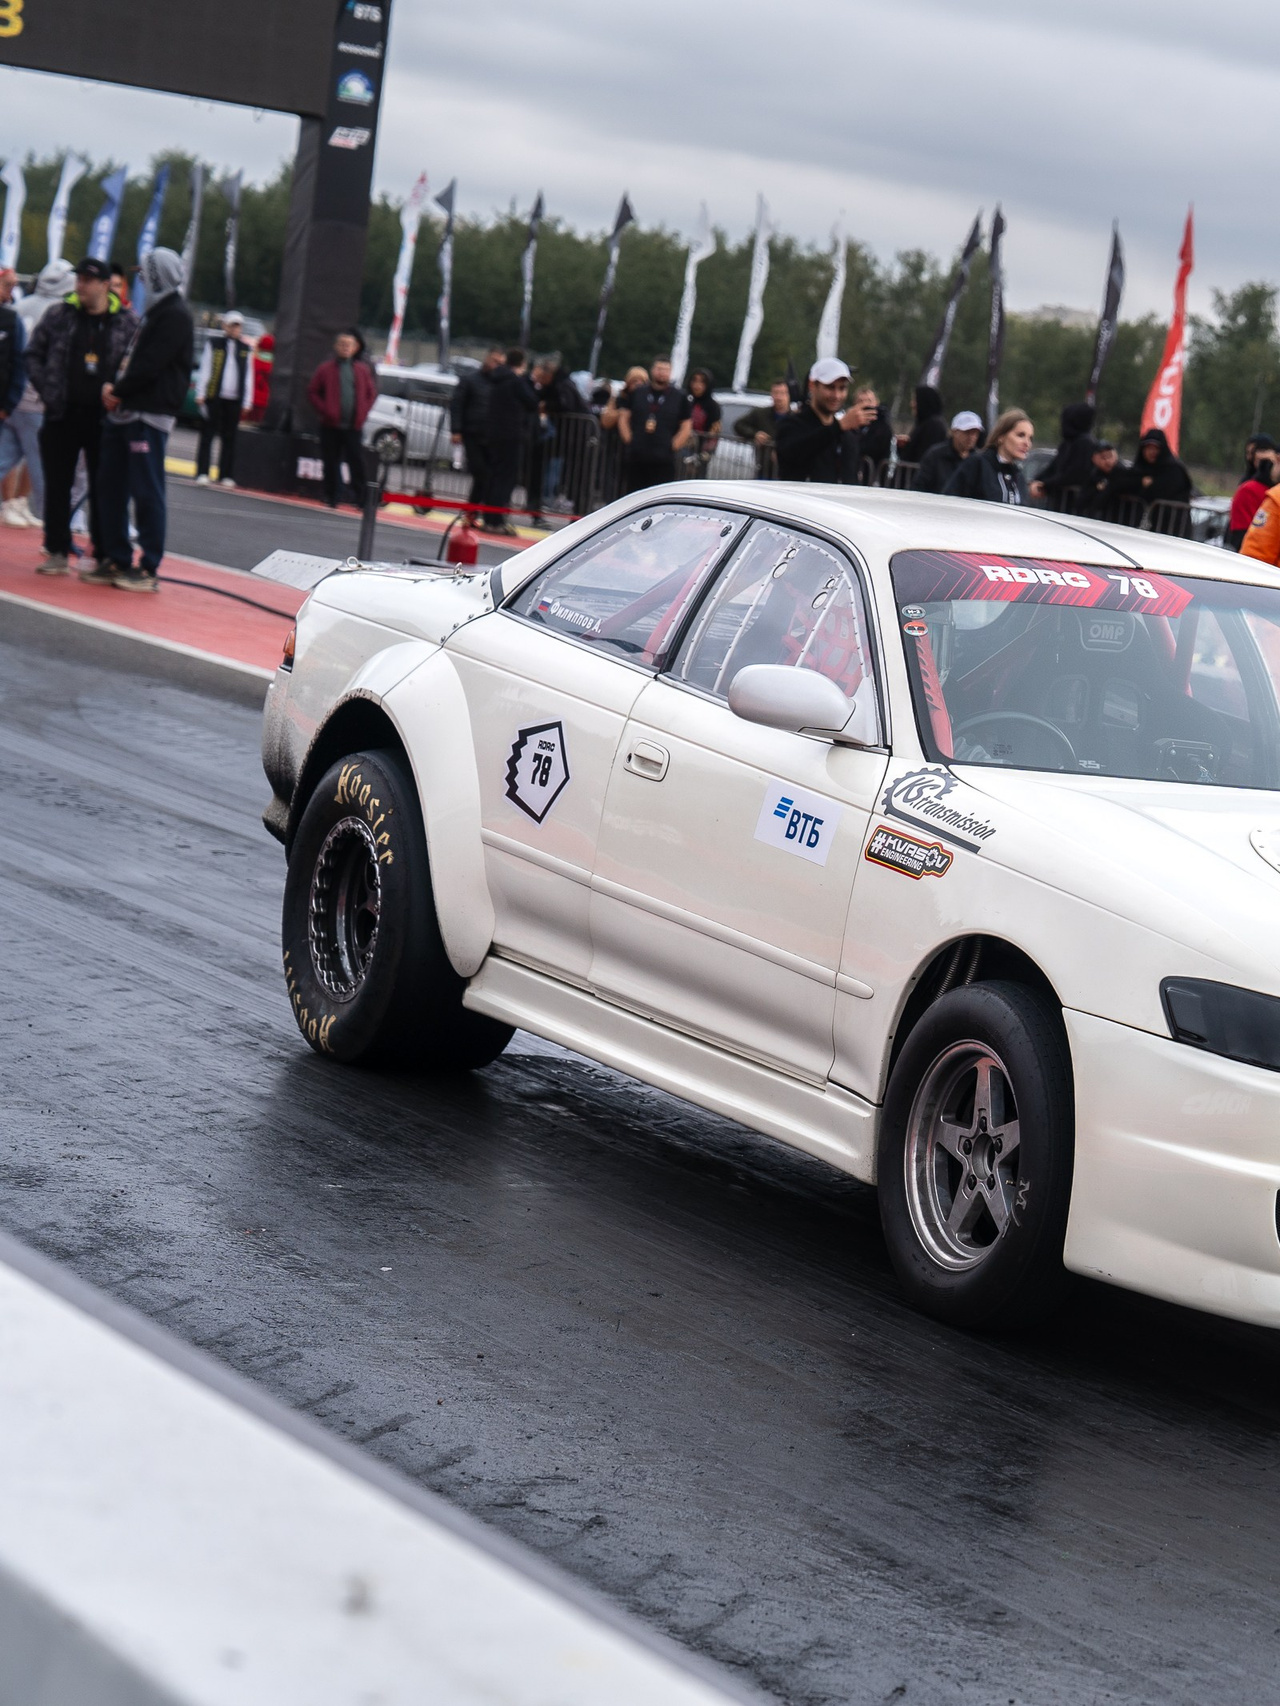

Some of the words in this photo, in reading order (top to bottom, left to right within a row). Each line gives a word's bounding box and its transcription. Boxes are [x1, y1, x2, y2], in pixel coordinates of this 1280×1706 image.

[979, 565, 1091, 589] RDRC
[1107, 574, 1160, 600] 78
[1089, 623, 1125, 640] OMP
[537, 739, 556, 753] RDRC
[531, 752, 552, 788] 78
[334, 763, 394, 866] Hoosier
[785, 808, 824, 849] ВТБ
[880, 847, 923, 871] ENGINEERING
